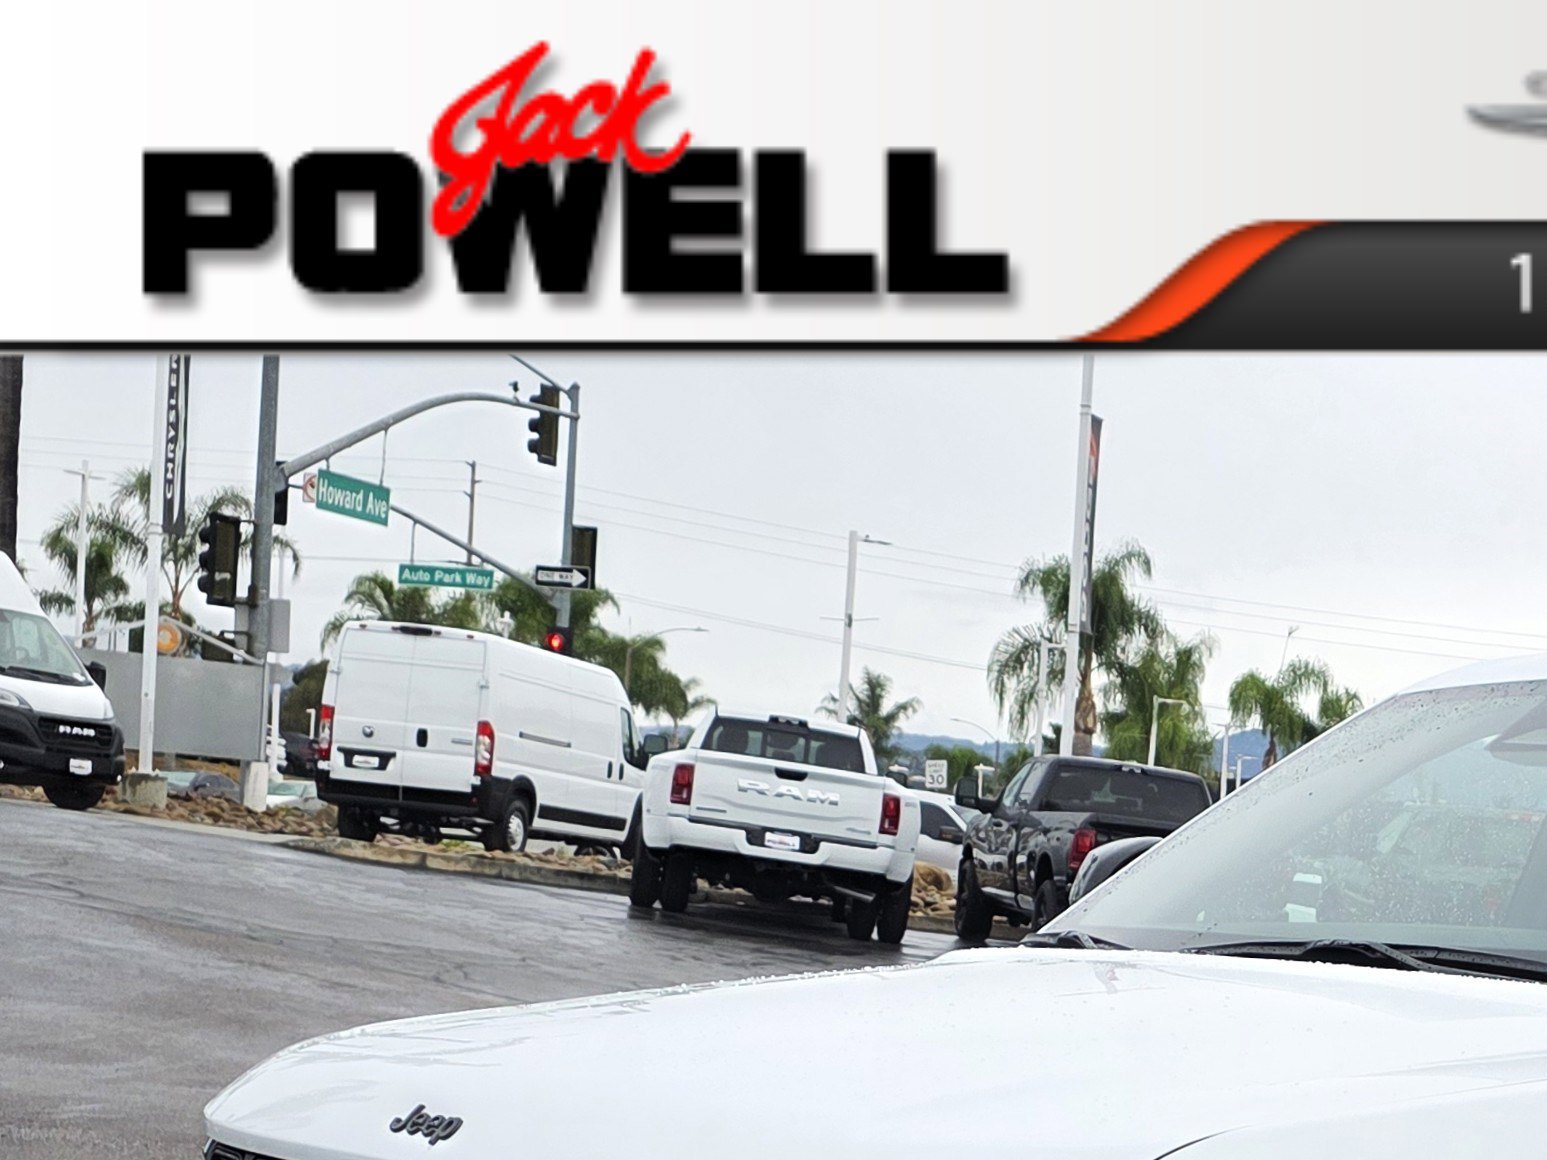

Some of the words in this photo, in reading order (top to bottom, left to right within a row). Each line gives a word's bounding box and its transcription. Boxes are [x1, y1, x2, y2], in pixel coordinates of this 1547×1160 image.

[318, 478, 363, 512] Howard
[366, 491, 388, 519] Ave
[402, 568, 430, 581] Auto
[434, 570, 462, 583] Park
[466, 573, 491, 586] Way
[58, 724, 96, 738] RAM
[928, 774, 945, 785] 30
[737, 778, 839, 806] RAM
[389, 1103, 464, 1146] Jeep
